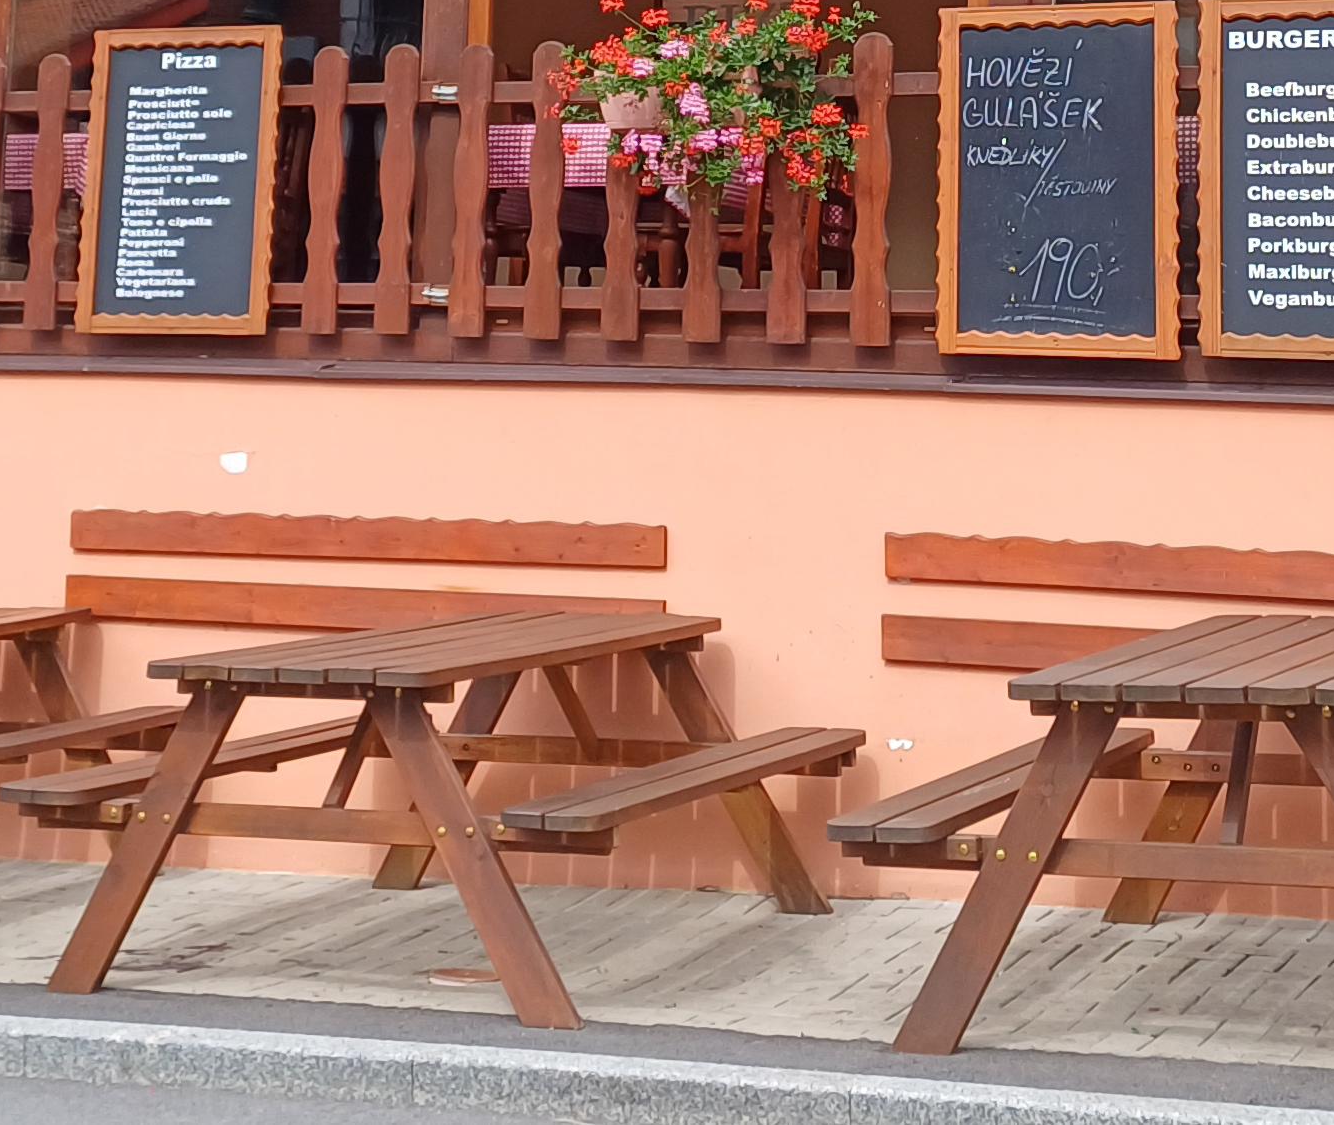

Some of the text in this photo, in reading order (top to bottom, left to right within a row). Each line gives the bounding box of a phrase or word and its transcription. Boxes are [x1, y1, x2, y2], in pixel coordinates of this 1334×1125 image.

[161, 51, 217, 70] Pizza
[966, 39, 1083, 88] HOVĚZÍ
[129, 86, 208, 97] Margherita
[127, 110, 200, 120] Prosciutto
[963, 91, 1103, 131] GULÁŠEK
